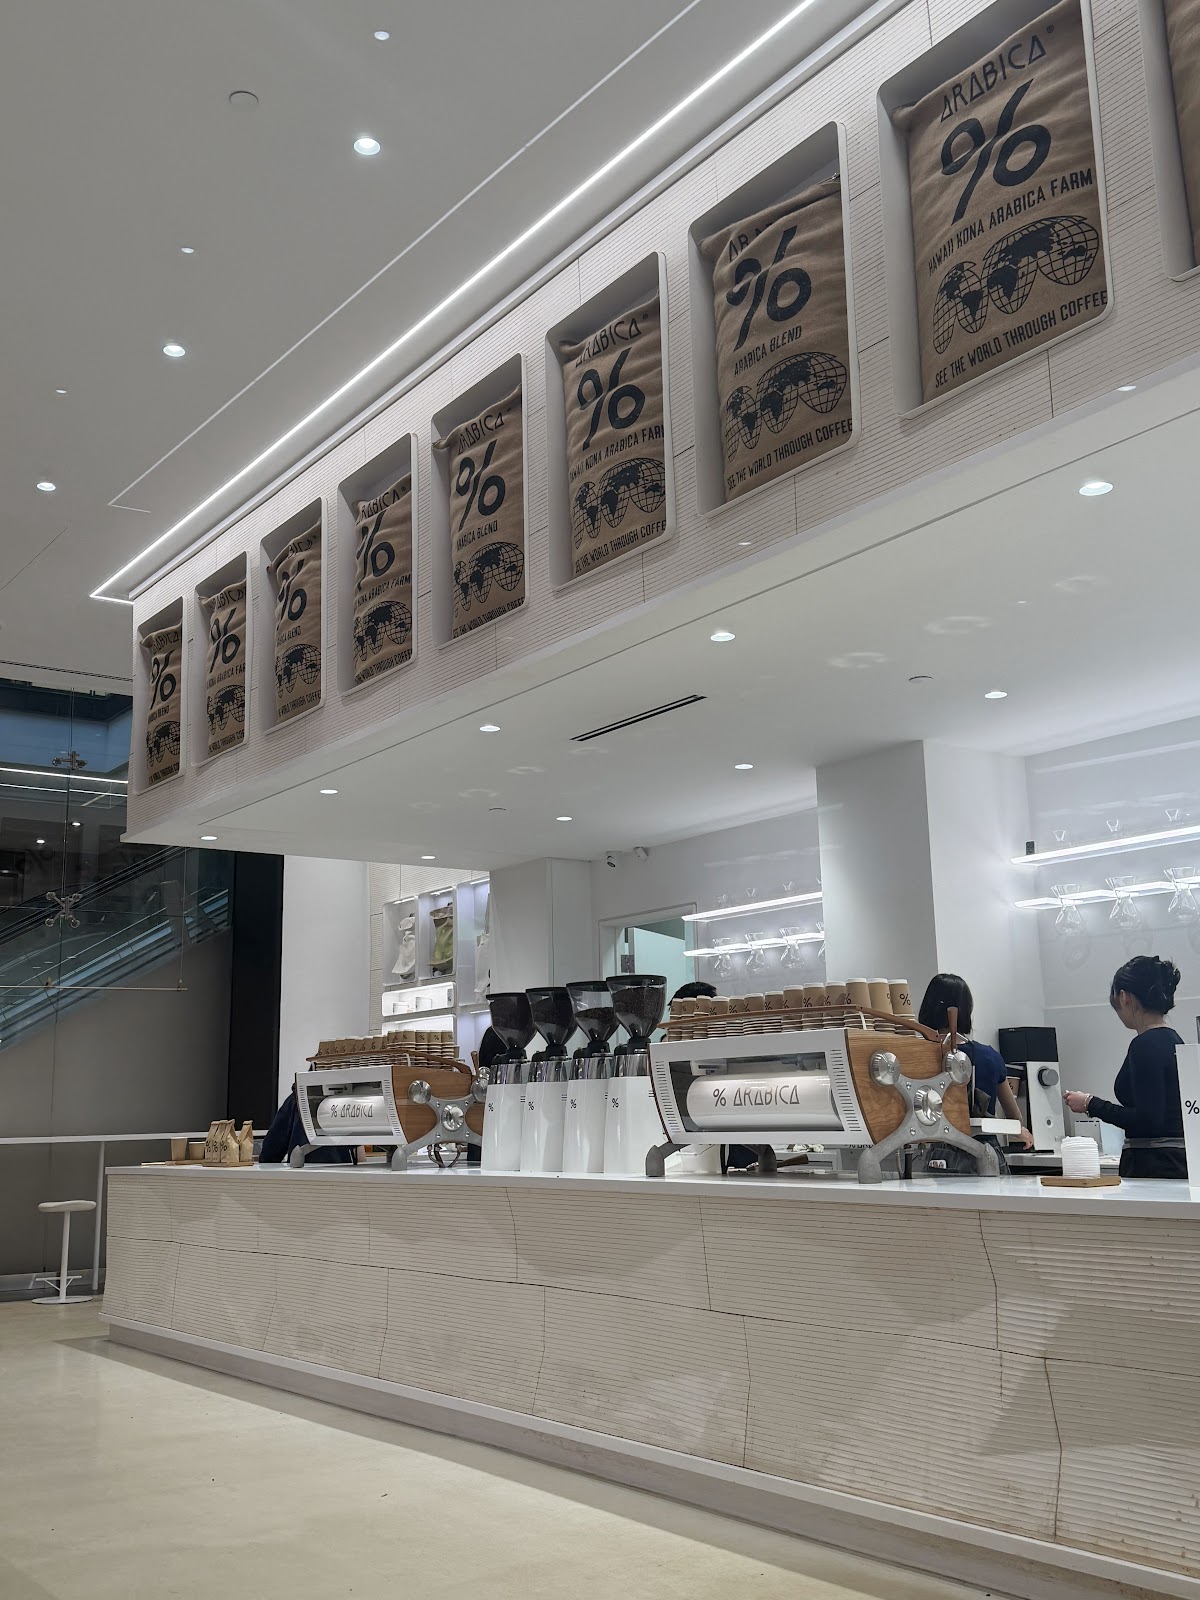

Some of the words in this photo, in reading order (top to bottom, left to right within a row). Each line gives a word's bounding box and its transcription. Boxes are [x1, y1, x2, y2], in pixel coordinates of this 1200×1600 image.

[928, 241, 954, 276] HAWAII
[956, 219, 985, 249] KONA
[989, 185, 1046, 229] ARABICA
[1050, 168, 1093, 197] FARM
[734, 343, 768, 376] ARABICA
[770, 325, 802, 352] BLEND
[935, 368, 948, 388] SEE
[950, 356, 966, 378] THE
[967, 339, 1003, 367] WORLD
[1003, 310, 1057, 348] THROUGH
[1060, 290, 1108, 320] COFFEE
[604, 432, 639, 459] ARABICA
[736, 467, 747, 482] THE
[748, 453, 772, 477] WORLD
[773, 432, 814, 462] THROUGH
[477, 520, 498, 539] BLEND
[340, 1103, 373, 1118] ARABICA
